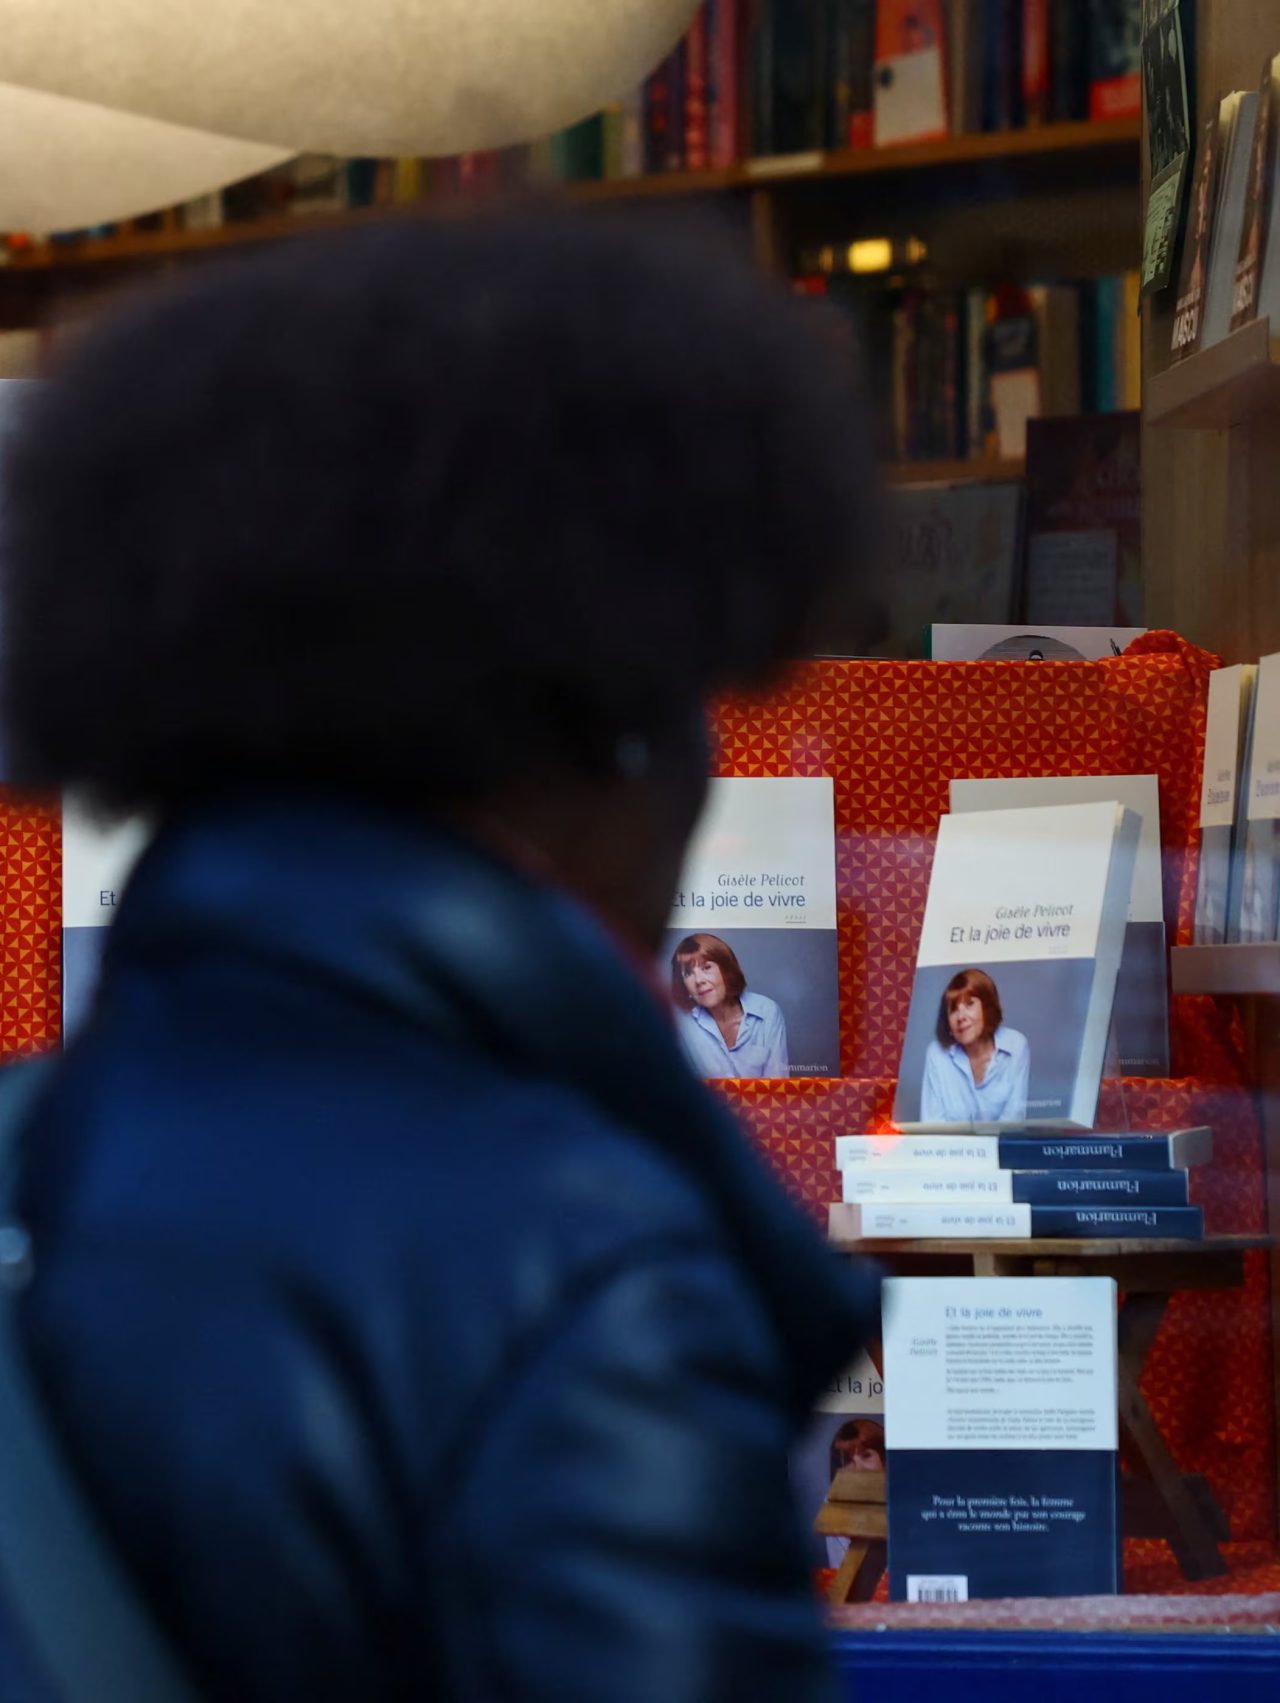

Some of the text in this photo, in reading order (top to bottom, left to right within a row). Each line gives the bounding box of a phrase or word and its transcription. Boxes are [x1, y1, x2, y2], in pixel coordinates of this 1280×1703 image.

[718, 874, 805, 887] Gisèle Pelicot
[100, 890, 117, 906] Et
[692, 892, 705, 907] la
[710, 892, 738, 911] joie
[743, 892, 763, 907] de
[768, 892, 805, 907] vivre
[950, 922, 1071, 945] Et la joie de vivre
[1043, 1144, 1123, 1158] Flammarion
[1057, 1180, 1140, 1193] Flammarion
[1076, 1212, 1157, 1225] Flammarion
[848, 1376, 862, 1394] la
[868, 1378, 883, 1398] jo
